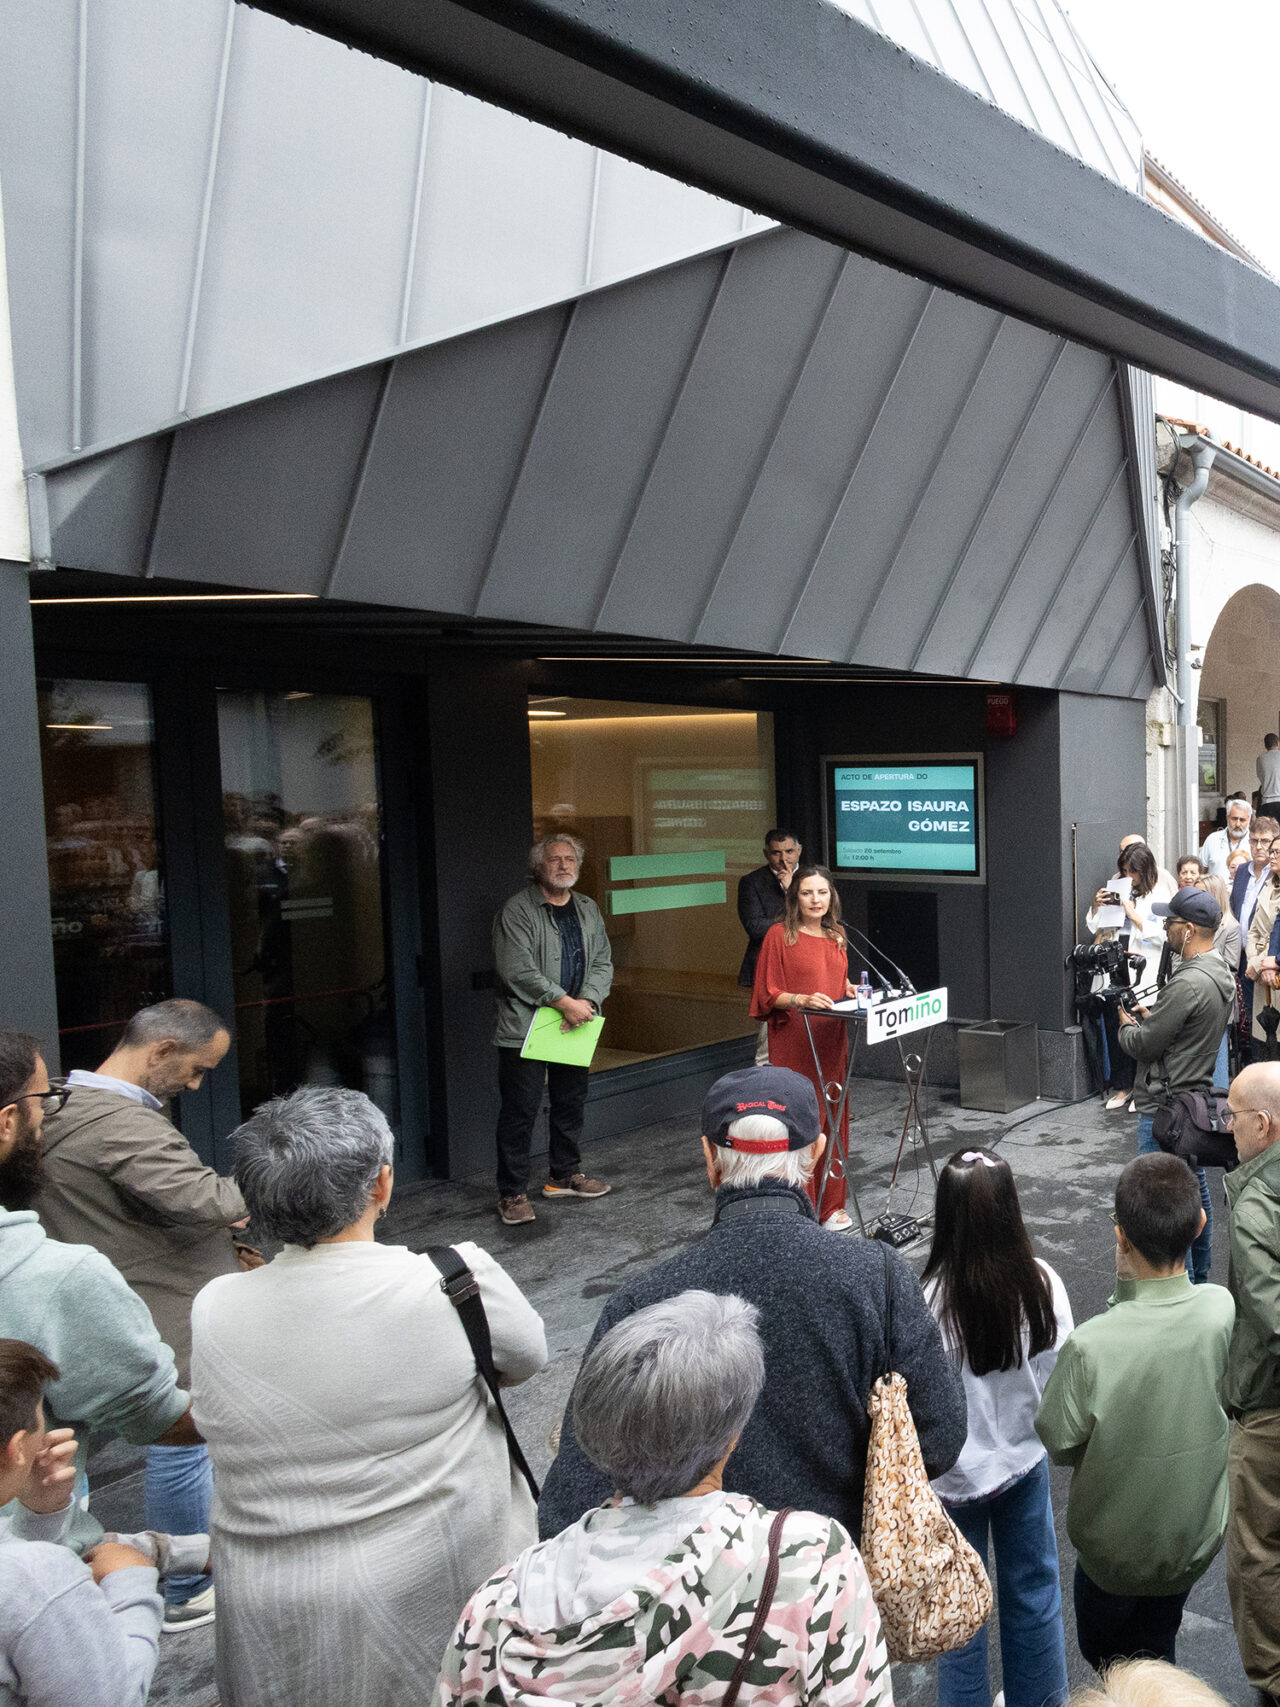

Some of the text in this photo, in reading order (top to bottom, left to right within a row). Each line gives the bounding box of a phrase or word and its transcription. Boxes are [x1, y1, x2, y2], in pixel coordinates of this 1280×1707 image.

[841, 800, 969, 812] ESPAZO ISAURA
[908, 818, 970, 832] GÓMEZ
